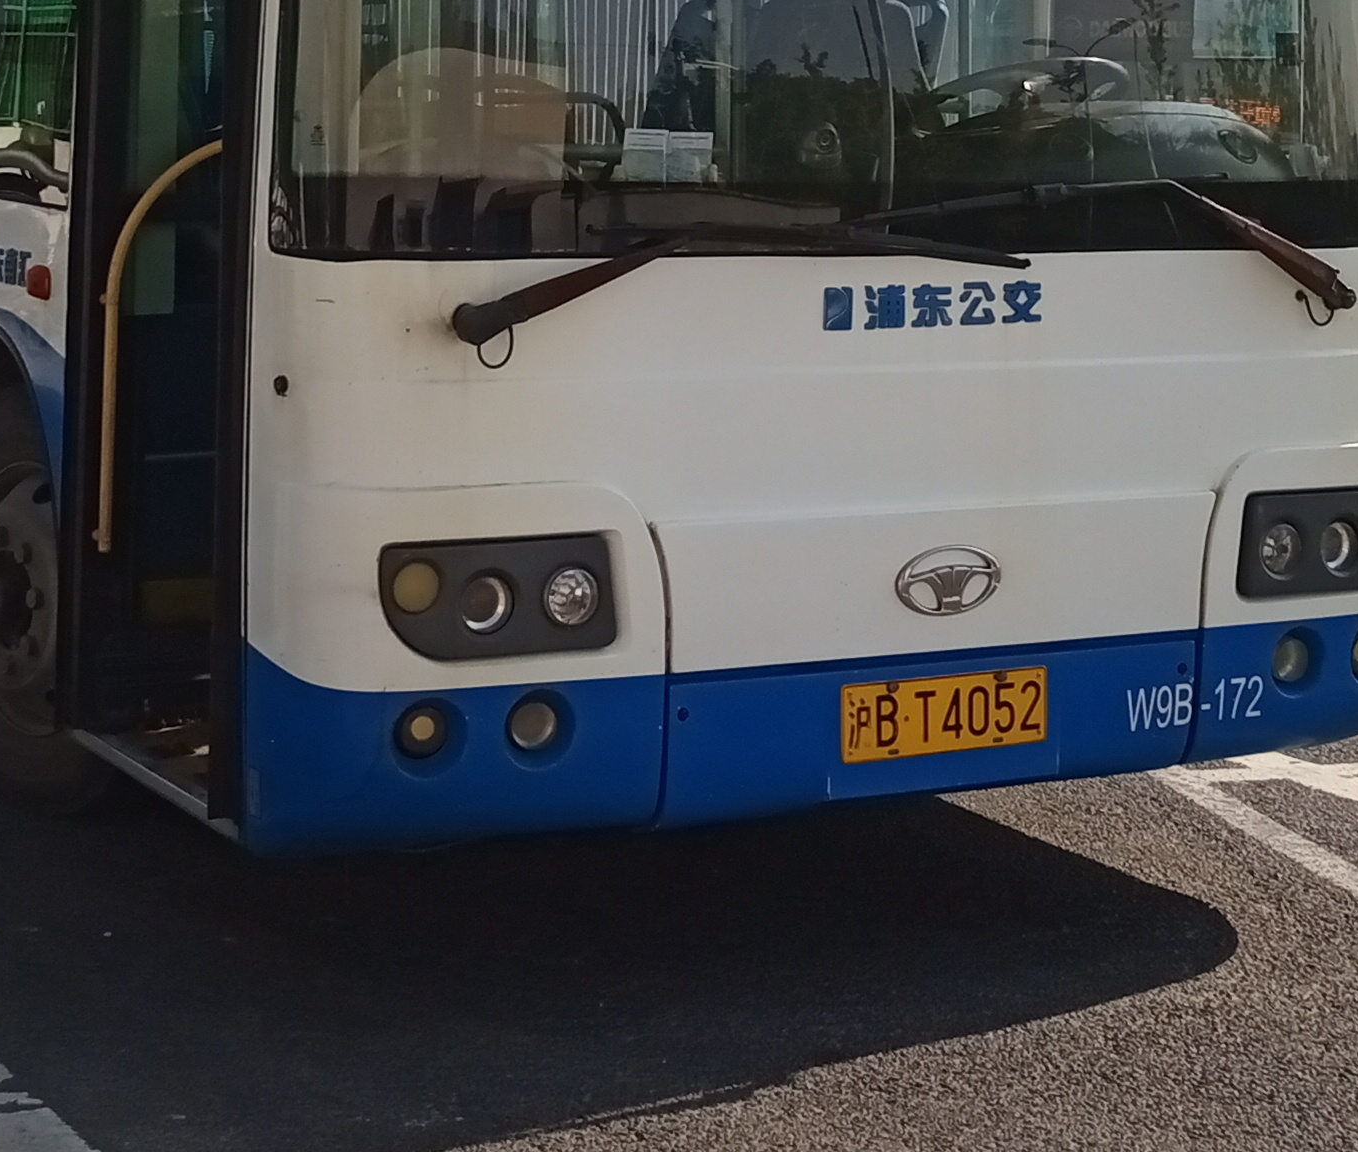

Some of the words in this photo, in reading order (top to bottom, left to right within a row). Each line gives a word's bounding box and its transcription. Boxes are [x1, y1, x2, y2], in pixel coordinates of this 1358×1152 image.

[863, 280, 1042, 330] 浦东公交
[1127, 675, 1264, 732] W9B-172
